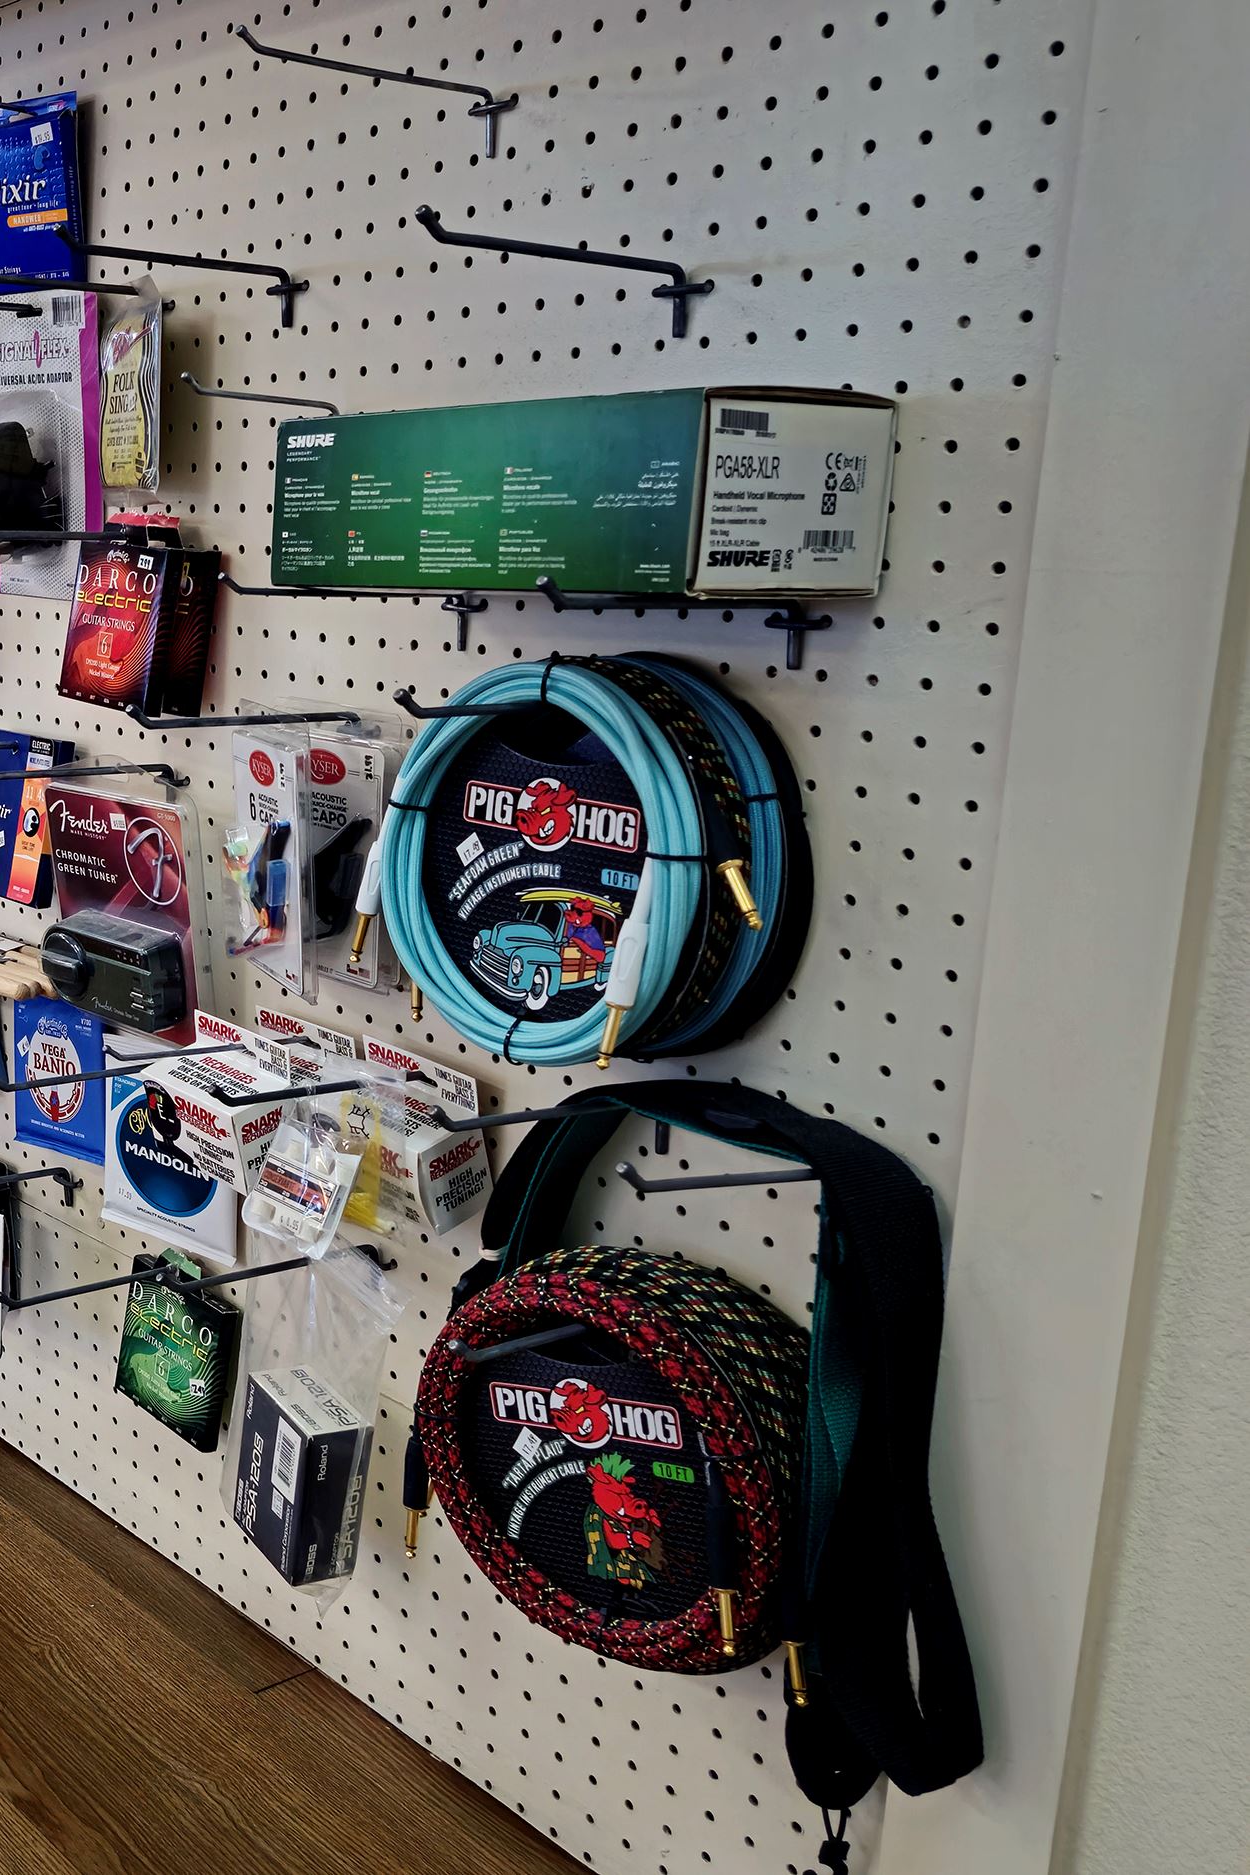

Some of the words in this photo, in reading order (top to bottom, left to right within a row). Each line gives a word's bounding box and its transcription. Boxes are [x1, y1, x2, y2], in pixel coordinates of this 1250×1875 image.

[37, 201, 48, 212] long
[13, 215, 41, 225] NANOWEB
[40, 338, 69, 358] FLEX
[27, 373, 45, 385] AC/DC
[46, 372, 72, 384] ADAPTOR
[112, 371, 136, 393] FOLK
[287, 433, 336, 449] SHURE
[715, 455, 780, 479] PGA58-XLR
[714, 491, 745, 500] Handheld
[746, 492, 766, 500] Vocal
[767, 492, 805, 501] Microphone
[707, 550, 771, 567] SHURE
[82, 613, 105, 626] GUITAR
[107, 618, 135, 632] STRINGS
[101, 635, 107, 654] 6
[32, 740, 51, 751] ELECTRIC
[251, 758, 274, 777] KYSER
[249, 793, 257, 821] 6
[311, 791, 347, 806] ACOUSTIC
[49, 799, 109, 834] Fender
[312, 808, 347, 826] CAPO
[467, 785, 514, 825] PIG
[576, 803, 638, 849] HOG
[55, 848, 106, 868] CHROMATIC
[57, 862, 86, 876] GREEN
[606, 872, 619, 885] 10
[621, 873, 634, 888] FT
[458, 885, 487, 920] VINTAGE
[483, 864, 530, 895] INSTRUMENT
[532, 863, 561, 879] CABLE
[199, 1016, 238, 1042] SNARK
[260, 1010, 300, 1034] SNARK
[317, 1028, 332, 1042] TUNES
[41, 1042, 66, 1058] VEGA
[368, 1042, 414, 1071] SNARK
[34, 1053, 76, 1075] BANJO
[178, 1057, 196, 1068] FROM
[197, 1062, 211, 1073] ANY
[212, 1070, 222, 1080] USB
[178, 1065, 192, 1074] ONE
[200, 1056, 257, 1084] RECHARGES
[114, 1076, 137, 1087] STANDARD
[168, 1069, 190, 1084] WEEKS
[190, 1078, 200, 1089] OR
[435, 1068, 452, 1083] TUNES
[174, 1096, 221, 1133] SNARK
[241, 1106, 283, 1137] SNARK
[201, 1138, 235, 1160] PRECISION
[429, 1136, 482, 1172] SNARK
[125, 1141, 210, 1182] MANDOLIN
[203, 1157, 235, 1178] BATTERIES
[435, 1168, 487, 1206] PRECISION
[449, 1167, 473, 1188] HIGH
[444, 1181, 484, 1212] TUNING!
[138, 1327, 162, 1350] GUITAR
[164, 1347, 192, 1371] STRINGS
[158, 1361, 165, 1376] 6
[247, 1383, 255, 1420] Roland
[495, 1387, 548, 1423] PIG
[613, 1404, 678, 1445] HOG
[317, 1444, 327, 1481] Roland
[658, 1464, 672, 1477] 10
[674, 1466, 688, 1481] FT
[507, 1500, 526, 1540] VINTAGE
[519, 1467, 560, 1505] INSTRUMENT
[557, 1460, 586, 1477] CABLE
